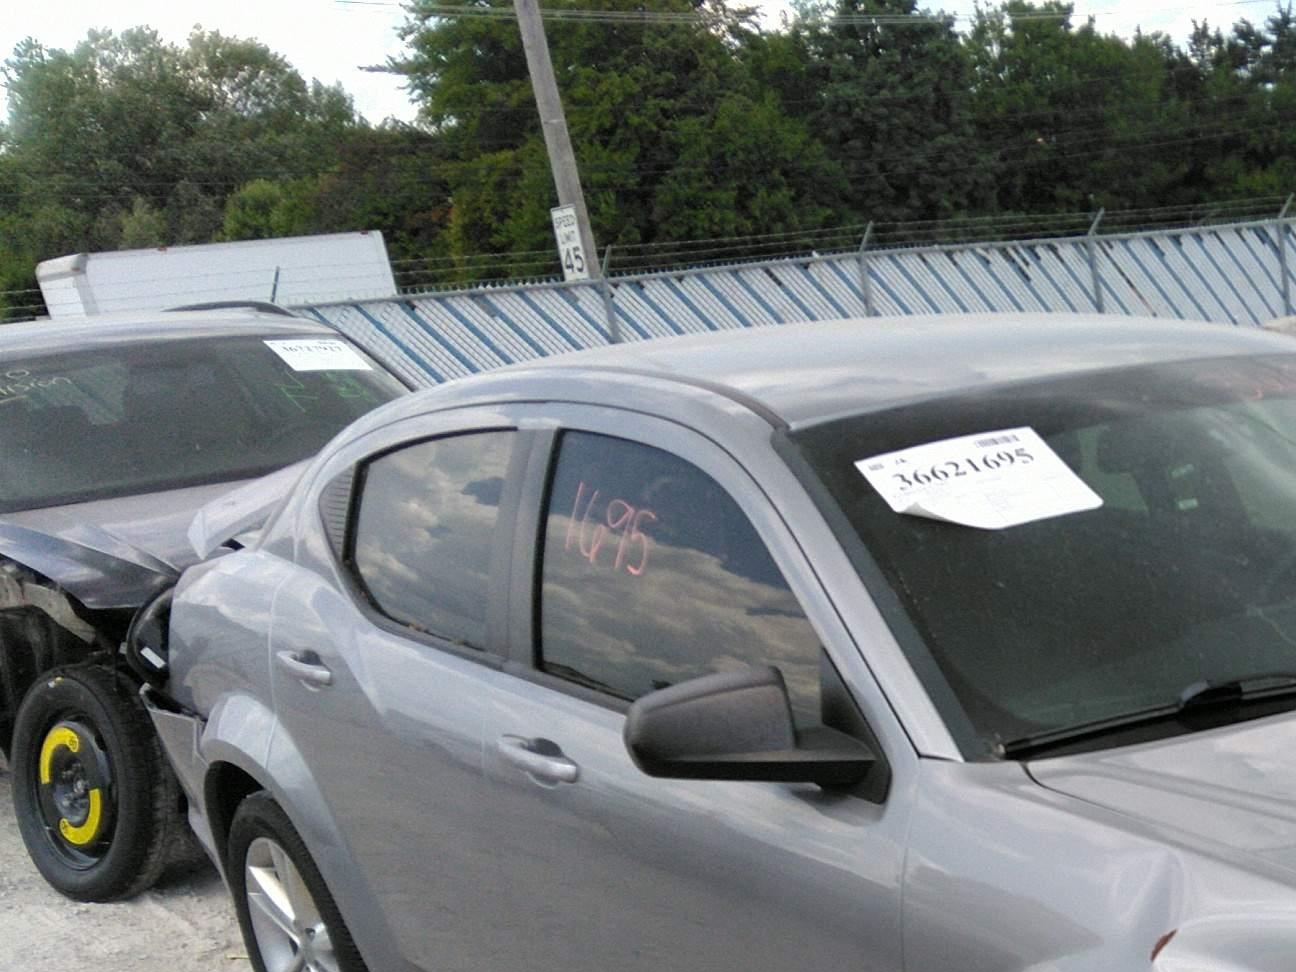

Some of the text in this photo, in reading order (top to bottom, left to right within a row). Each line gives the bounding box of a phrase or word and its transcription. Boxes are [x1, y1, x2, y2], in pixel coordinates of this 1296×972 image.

[565, 246, 585, 273] 45
[892, 448, 1035, 490] 36621695
[564, 481, 657, 577] 1695
